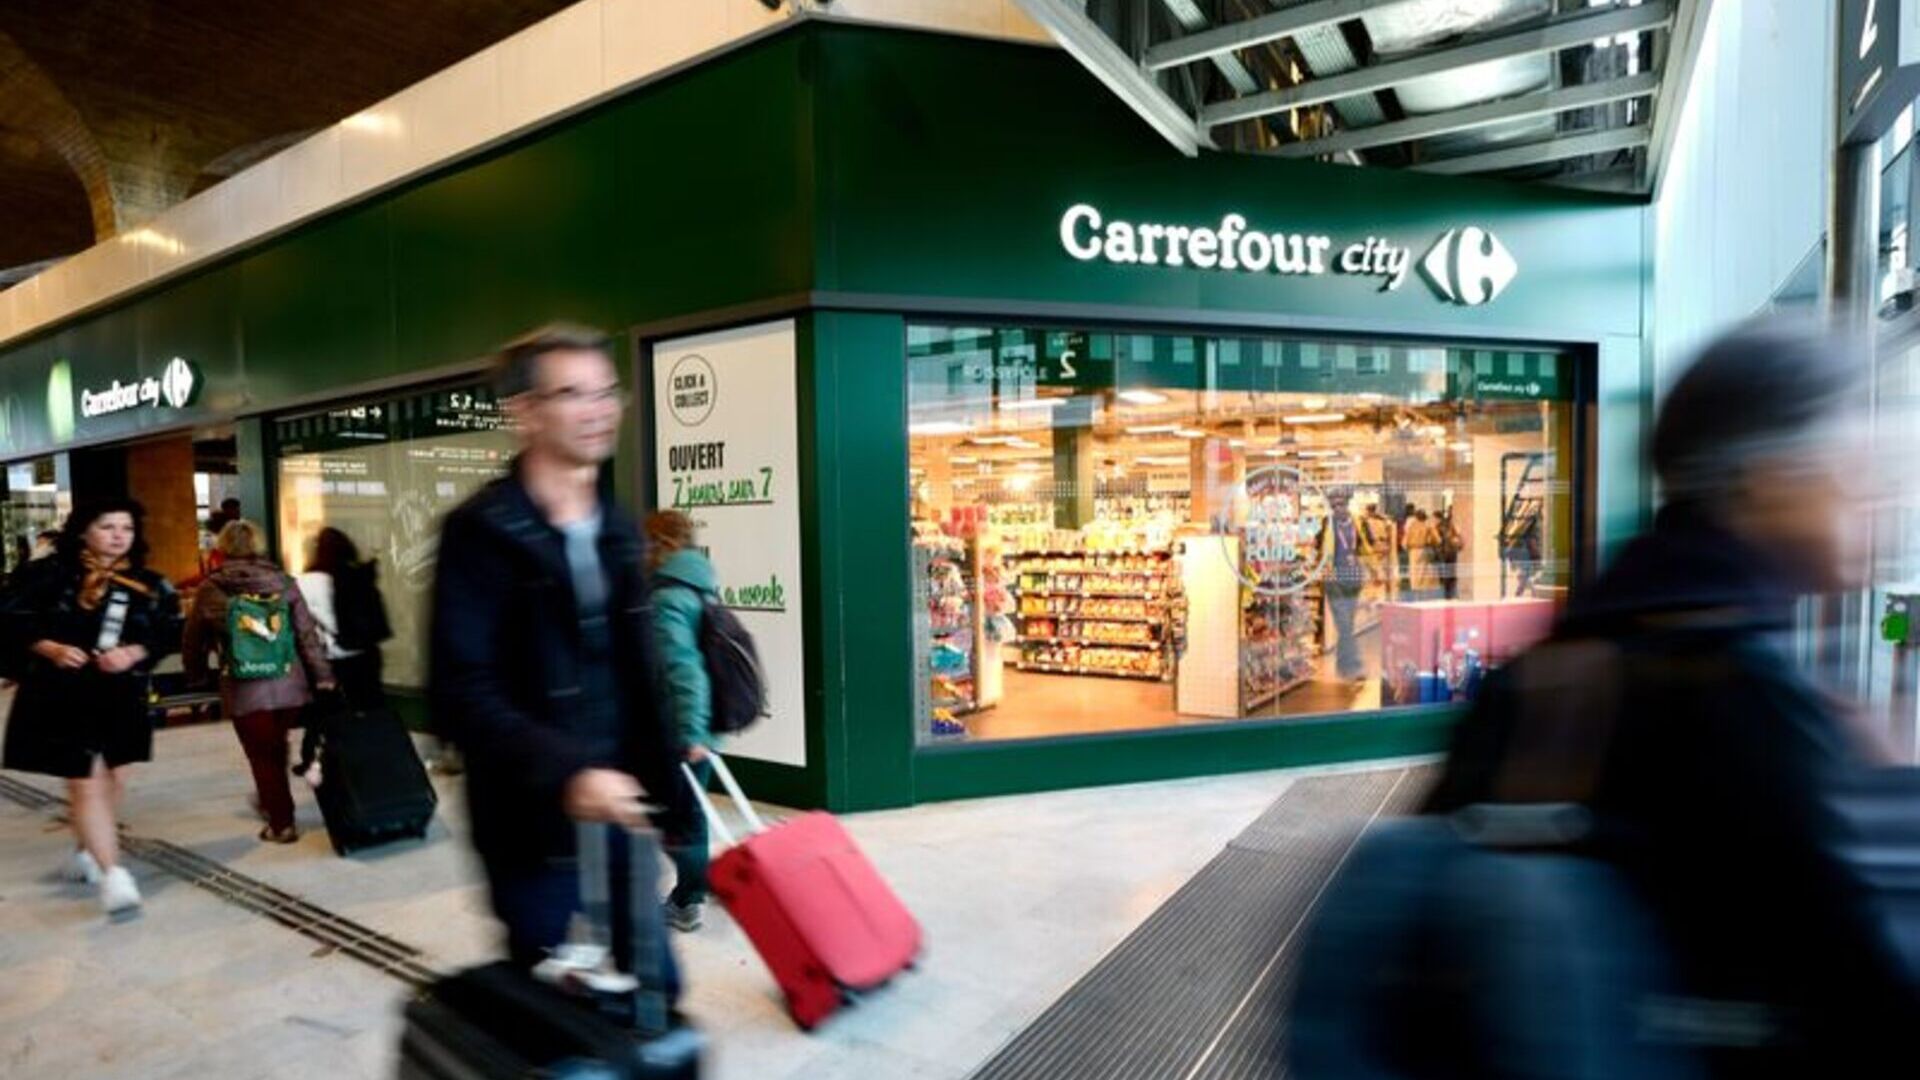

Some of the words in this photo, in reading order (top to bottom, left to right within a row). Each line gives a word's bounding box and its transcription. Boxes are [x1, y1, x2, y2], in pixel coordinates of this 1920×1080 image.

[1060, 204, 1330, 275] Carrefour
[1340, 237, 1411, 290] city
[81, 380, 139, 418] Carrefour
[140, 377, 160, 408] city
[674, 374, 697, 391] CLICK
[674, 390, 709, 408] COLLECT
[669, 442, 725, 472] OUVERT
[672, 476, 683, 507] 7
[685, 475, 726, 514] jours
[728, 479, 756, 501] sur
[760, 467, 773, 499] 7
[724, 586, 737, 605] a
[739, 573, 785, 608] week
